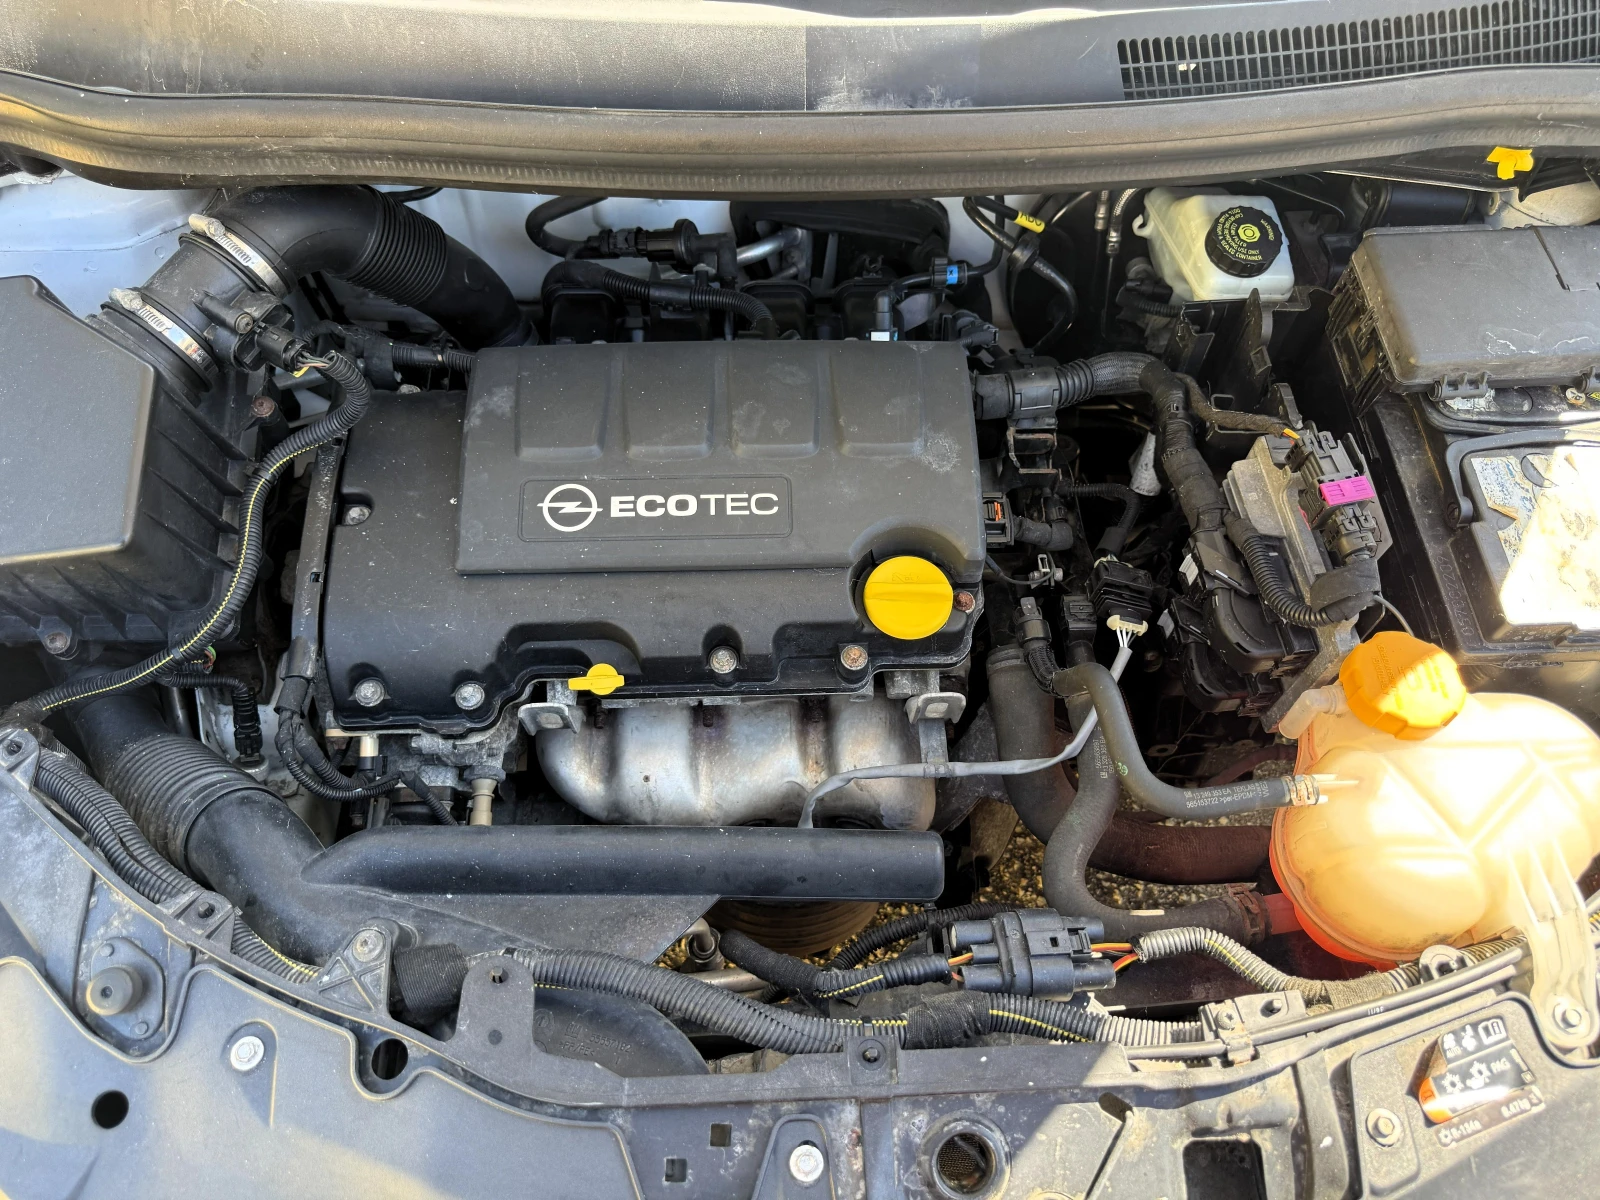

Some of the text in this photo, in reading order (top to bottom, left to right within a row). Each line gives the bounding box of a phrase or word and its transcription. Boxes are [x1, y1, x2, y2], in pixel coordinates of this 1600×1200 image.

[1224, 229, 1238, 249] REMOVING
[1260, 219, 1274, 240] WARNING
[1221, 240, 1235, 254] SEALED
[1235, 252, 1262, 261] CONTAINER
[1232, 236, 1247, 247] FILLER
[610, 493, 779, 518] ECOTEC
[1222, 787, 1232, 795] EA
[1233, 784, 1256, 793] TEKLAS
[589, 1033, 632, 1053] 55557182
